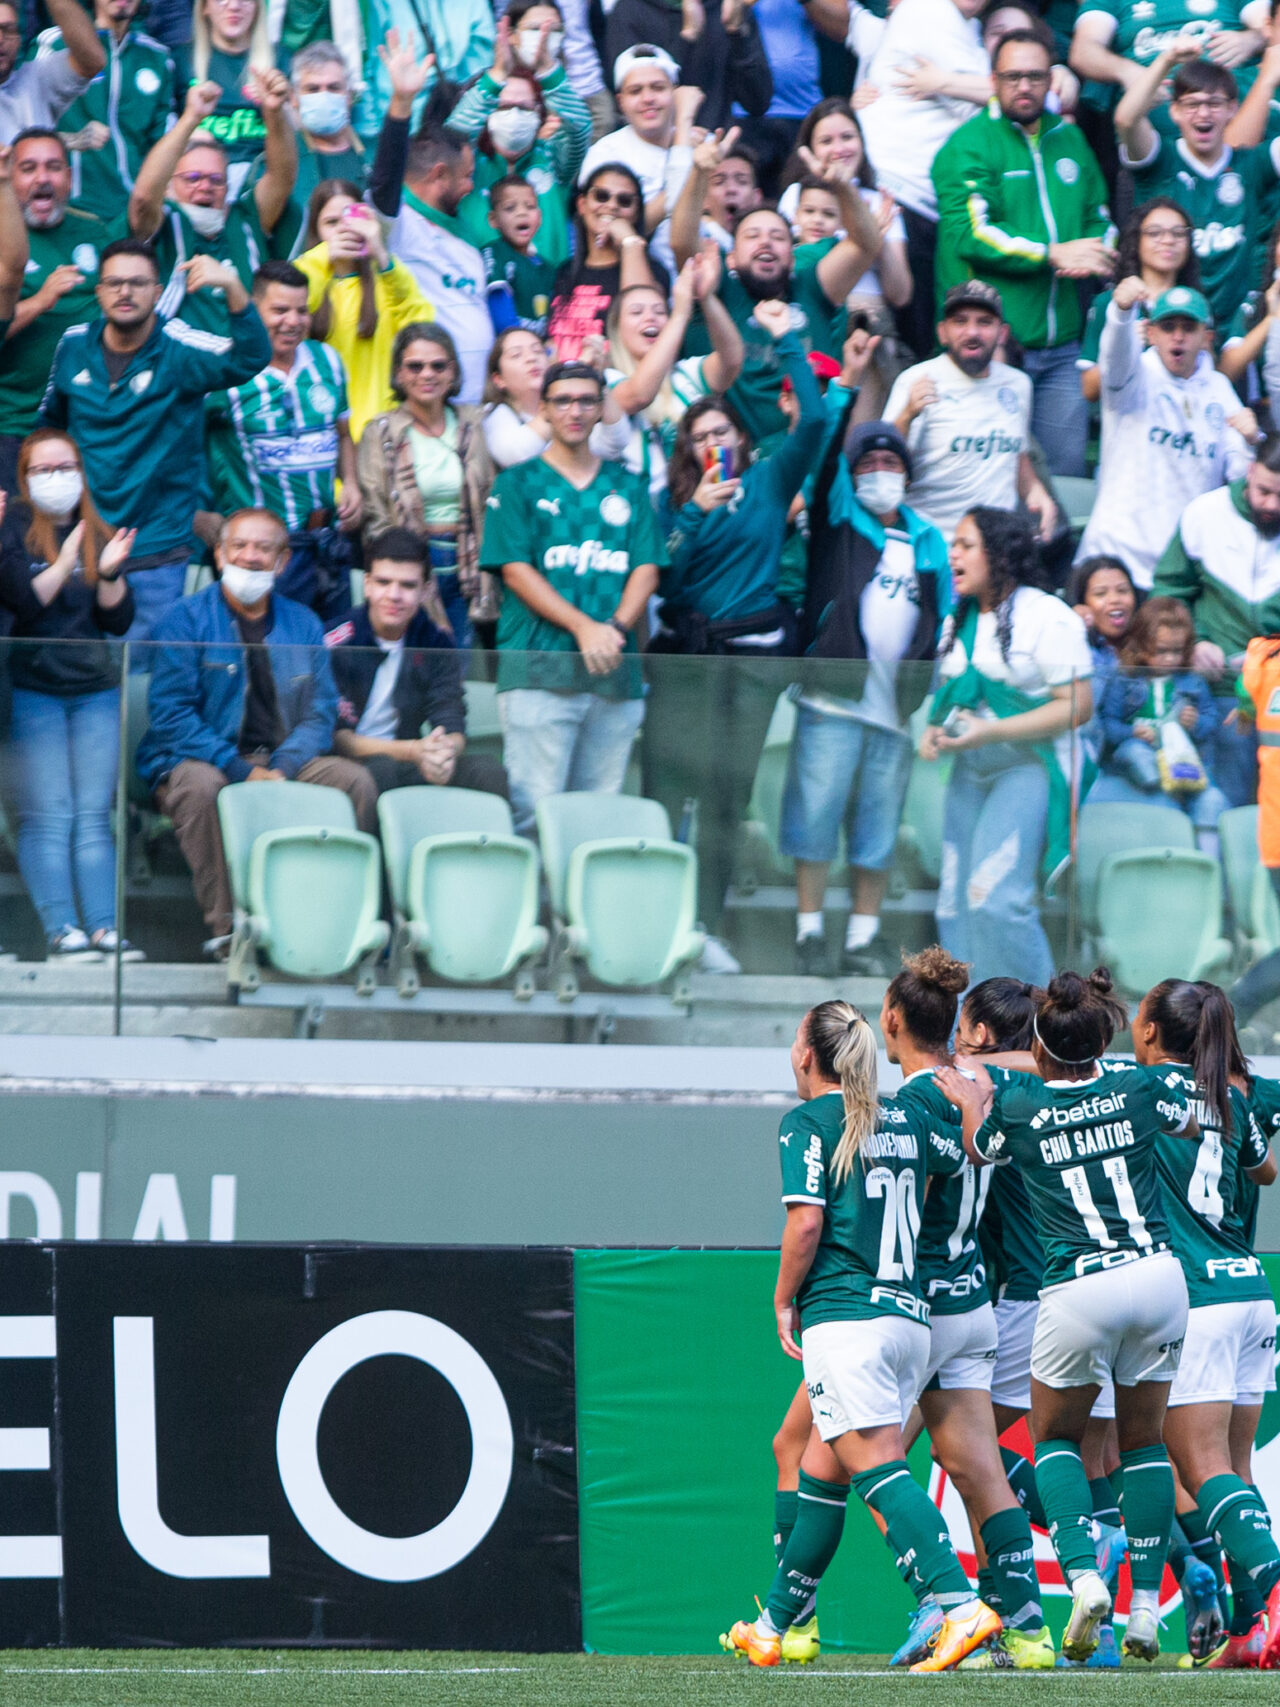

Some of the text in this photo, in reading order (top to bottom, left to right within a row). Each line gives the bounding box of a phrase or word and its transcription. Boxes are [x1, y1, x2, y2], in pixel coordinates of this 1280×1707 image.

[949, 419, 1021, 461] crefisa
[545, 539, 630, 576] crefisa
[1053, 1092, 1128, 1127] betfair
[804, 1133, 823, 1194] crefisa
[1039, 1119, 1135, 1165] CHÚ SANTOS
[865, 1166, 922, 1282] 20
[1060, 1155, 1154, 1250] 11
